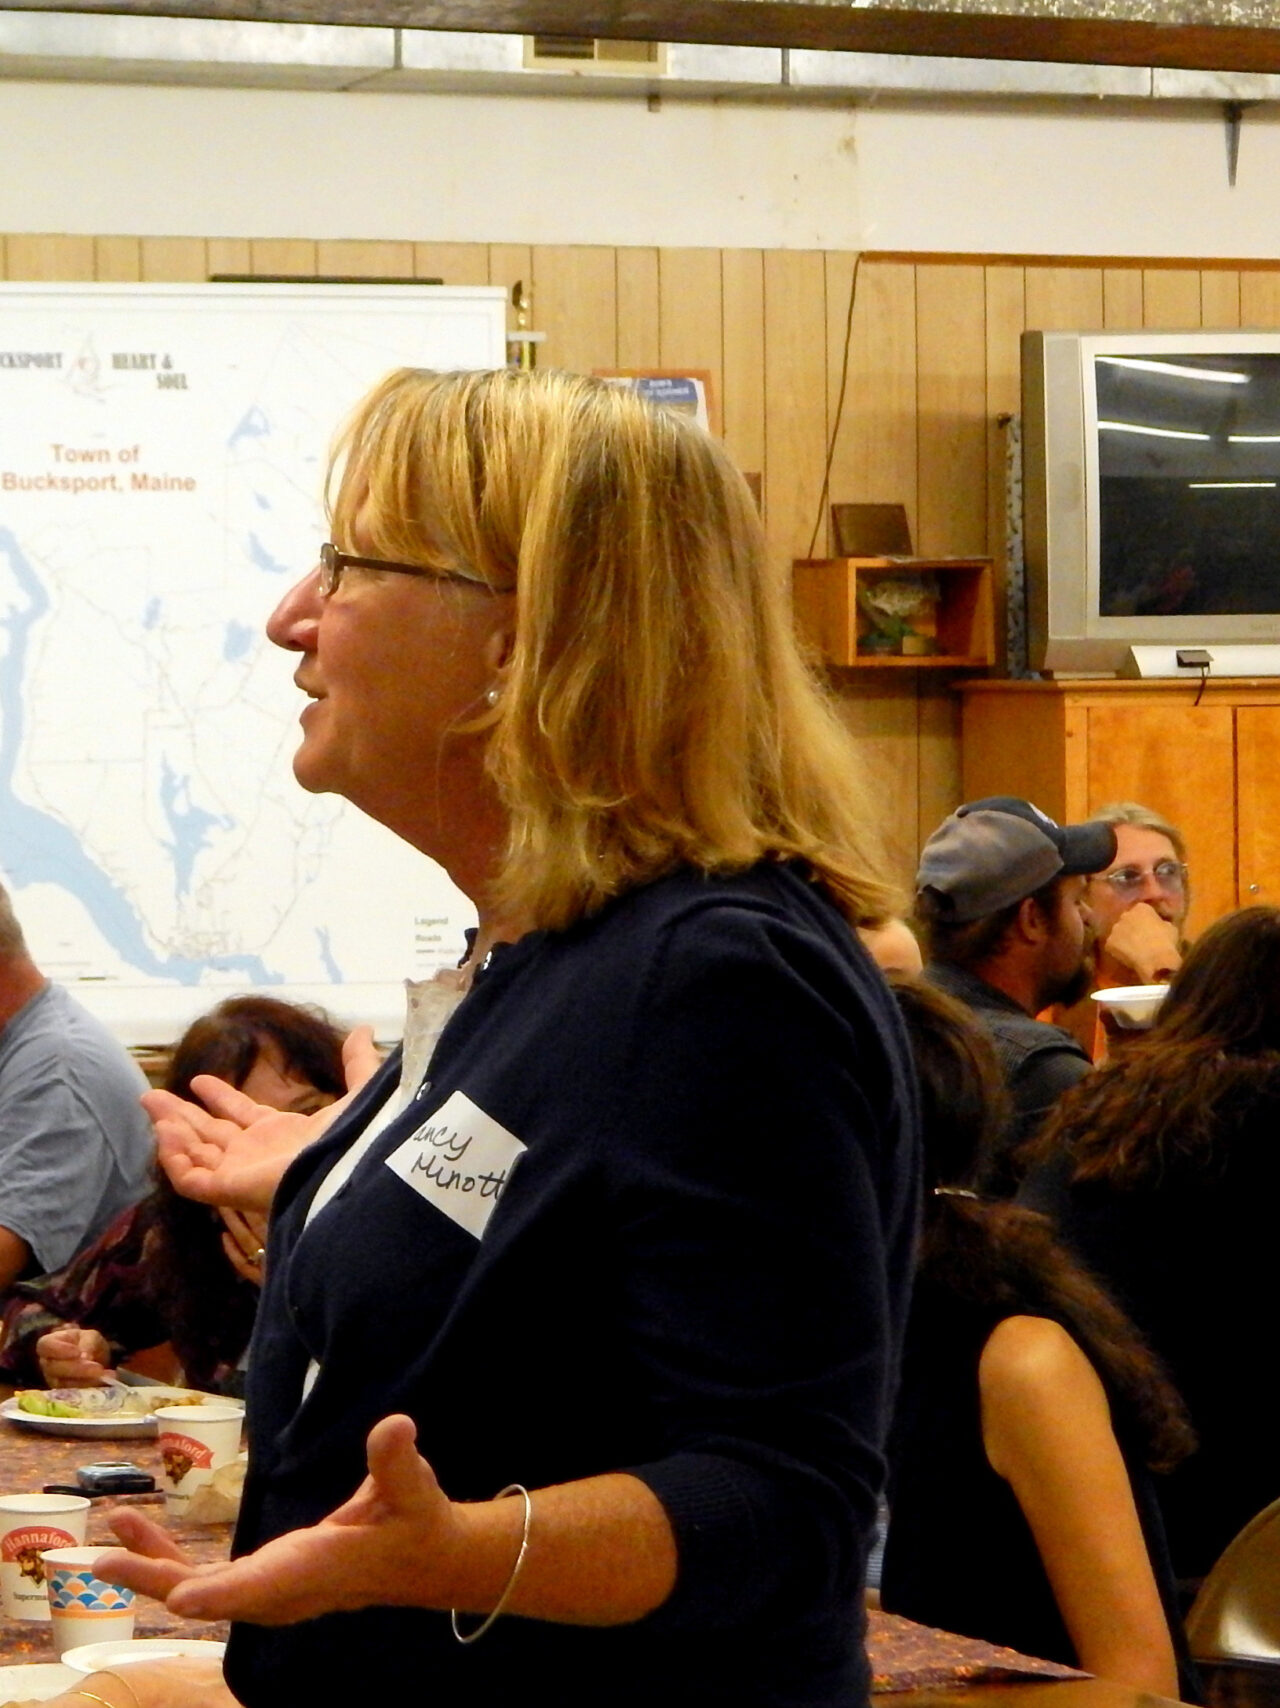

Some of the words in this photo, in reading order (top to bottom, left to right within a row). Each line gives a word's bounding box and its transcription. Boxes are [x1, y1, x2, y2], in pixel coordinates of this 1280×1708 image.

[50, 443, 111, 463] Town
[117, 443, 141, 463] of
[0, 471, 123, 495] Bucksport,
[130, 471, 197, 492] Maine
